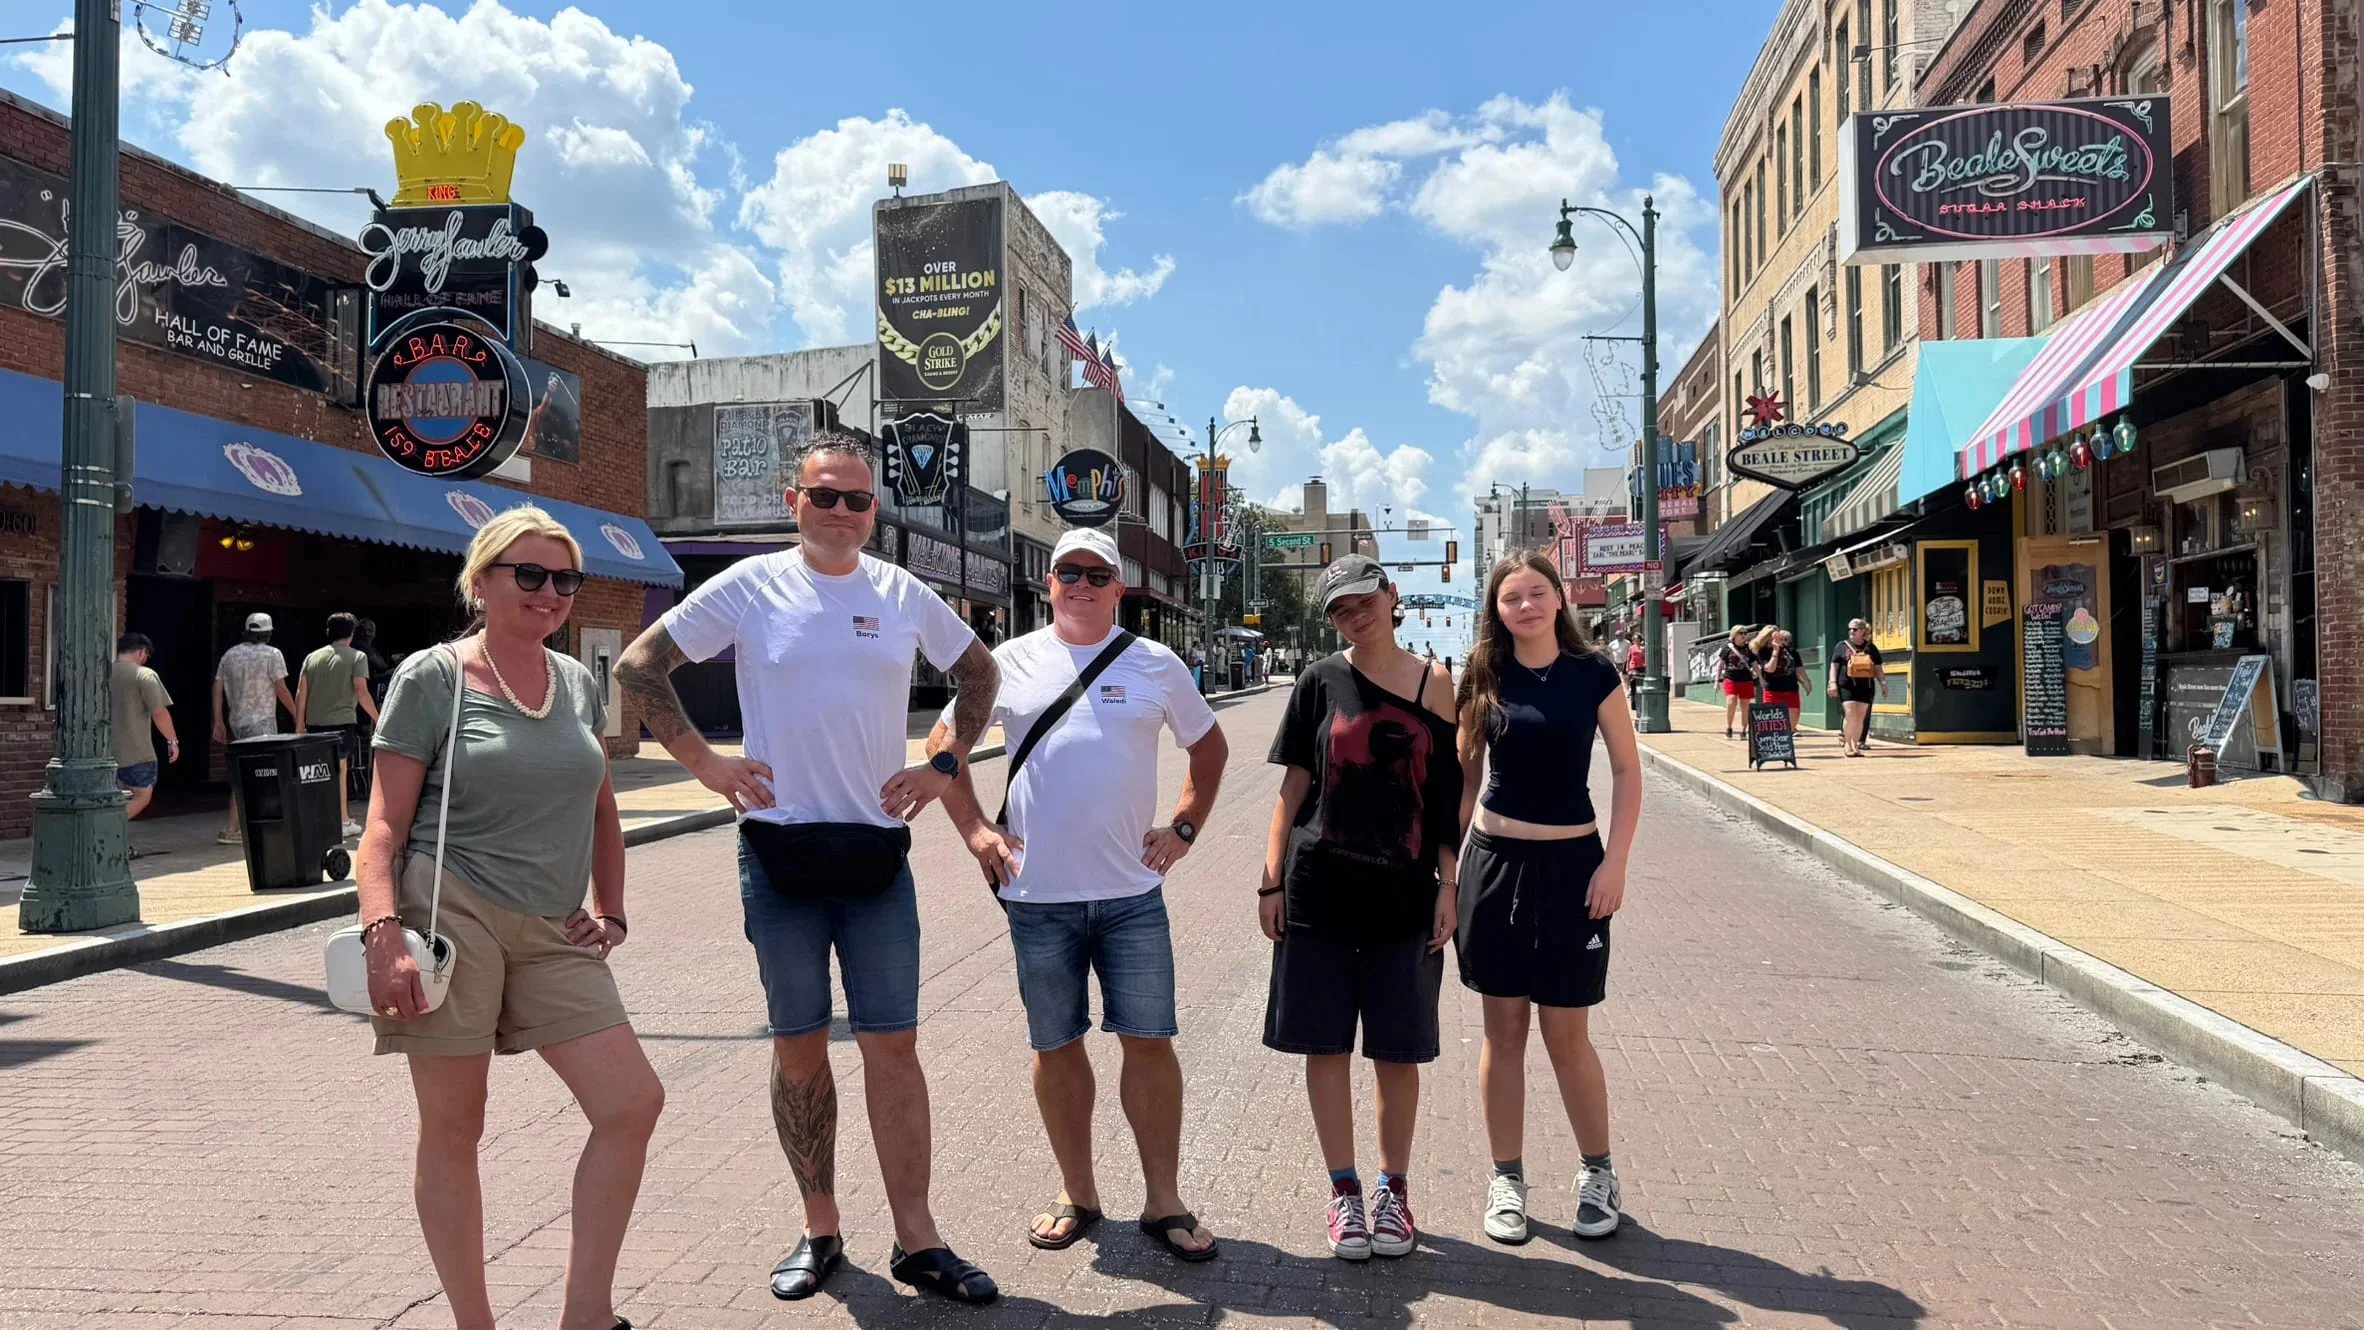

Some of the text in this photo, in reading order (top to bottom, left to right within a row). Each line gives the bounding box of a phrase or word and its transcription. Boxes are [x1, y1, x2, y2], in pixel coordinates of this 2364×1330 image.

[1890, 127, 2130, 198] Beale Sweets
[427, 184, 457, 200] KING
[1938, 197, 2086, 216] SUGAR SHACK
[358, 210, 529, 293] Jerry Lawler
[923, 261, 957, 275] OVER
[885, 269, 996, 297] $13 MILLION
[892, 290, 990, 305] IN JACKPOTS EVERY MONTH
[912, 306, 970, 320] CHA-BLING!
[155, 307, 283, 361] HALL OF FAME
[167, 329, 272, 371] BAR AND GRILLE
[408, 332, 470, 361] BAR
[928, 345, 954, 359] GOLD
[924, 357, 957, 371] STRIKE
[384, 423, 492, 468] 159 BEALE
[1742, 451, 1789, 466] BEALE
[1793, 447, 1850, 462] STREET
[724, 459, 767, 477] Bar
[1268, 536, 1311, 546] S Second St
[1751, 708, 1785, 721] Worlds
[1754, 719, 1788, 732] HOTTEST
